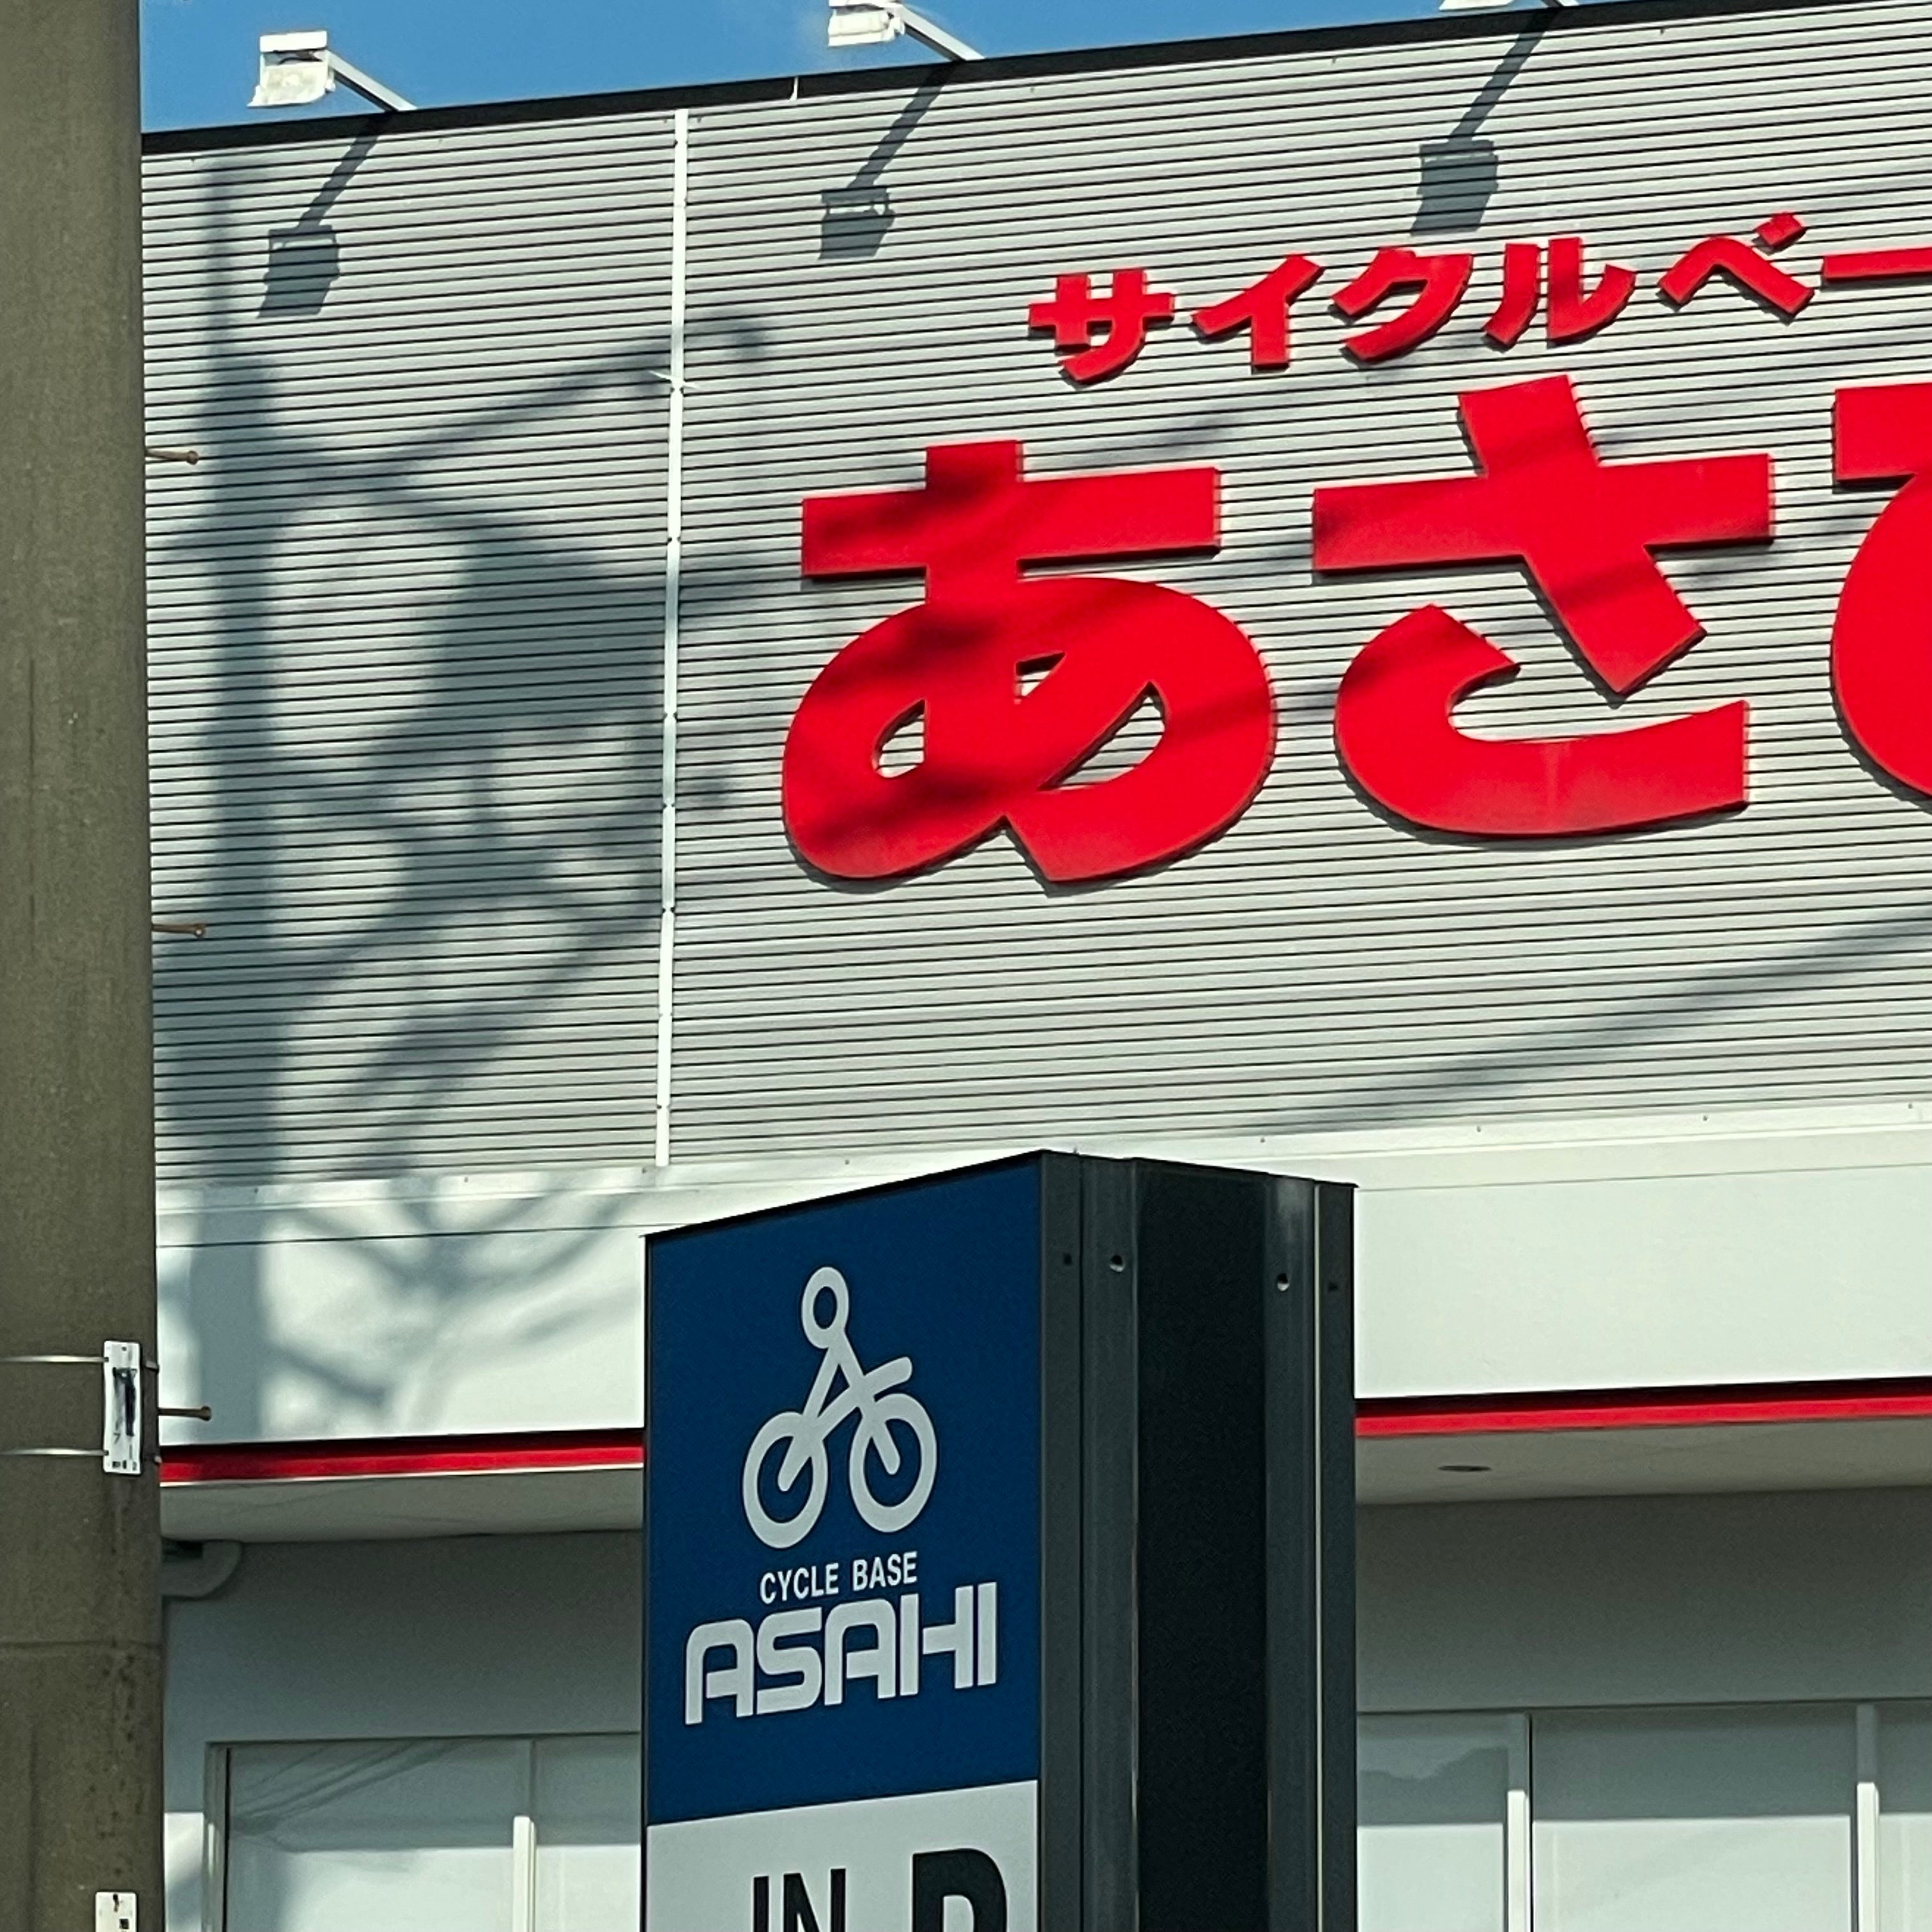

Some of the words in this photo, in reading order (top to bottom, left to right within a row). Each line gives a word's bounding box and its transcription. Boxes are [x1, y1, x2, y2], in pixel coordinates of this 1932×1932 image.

[1028, 211, 1932, 381] サイクルベー
[781, 374, 1932, 882] あさ
[685, 1581, 997, 1725] ASAHI
[760, 1562, 839, 1604] CYCLE
[853, 1551, 917, 1591] BASE
